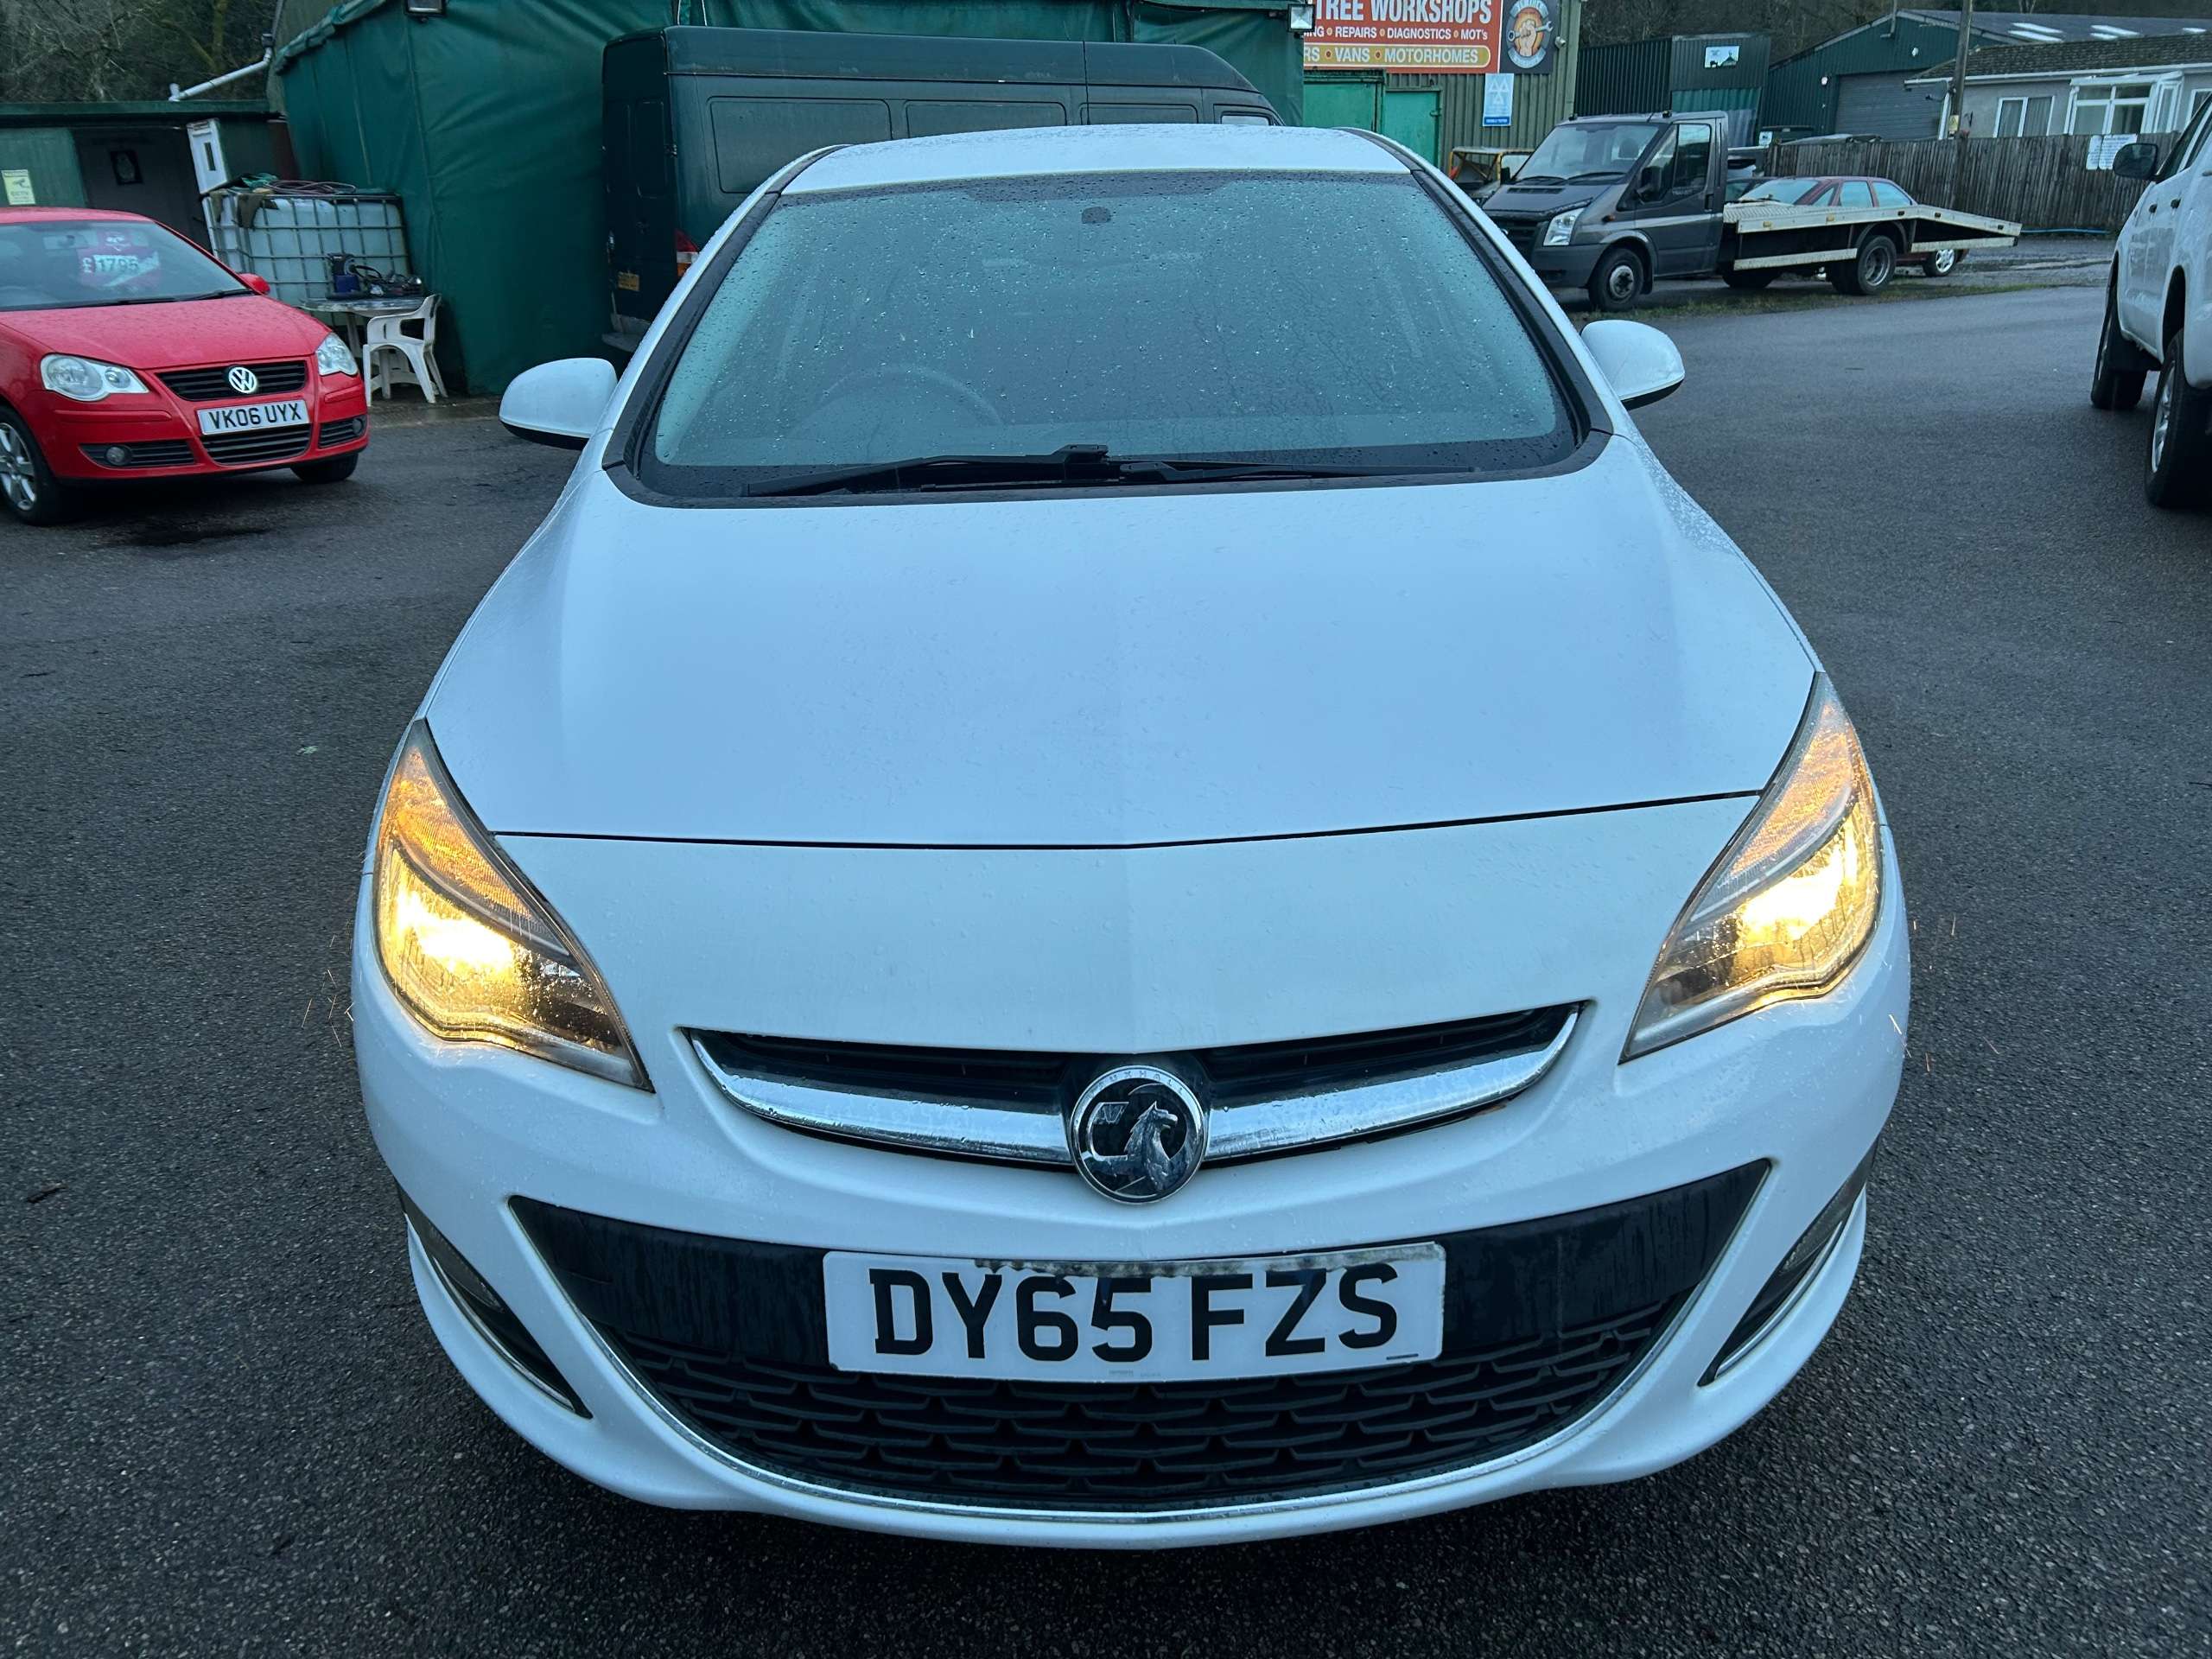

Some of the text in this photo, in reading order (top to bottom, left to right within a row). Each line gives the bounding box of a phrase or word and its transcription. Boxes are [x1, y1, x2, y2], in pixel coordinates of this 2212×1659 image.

[1370, 0, 1492, 24] WORKSHOPS
[1335, 26, 1377, 39] REPAIRS
[1387, 28, 1452, 40] DIAGNOSTICS
[1460, 29, 1488, 41] MOT's
[1335, 47, 1370, 63] VANS
[1384, 48, 1478, 64] MOTORHOMES
[208, 402, 302, 429] VK06 UYX
[868, 1262, 1398, 1363] DY65 FZS
